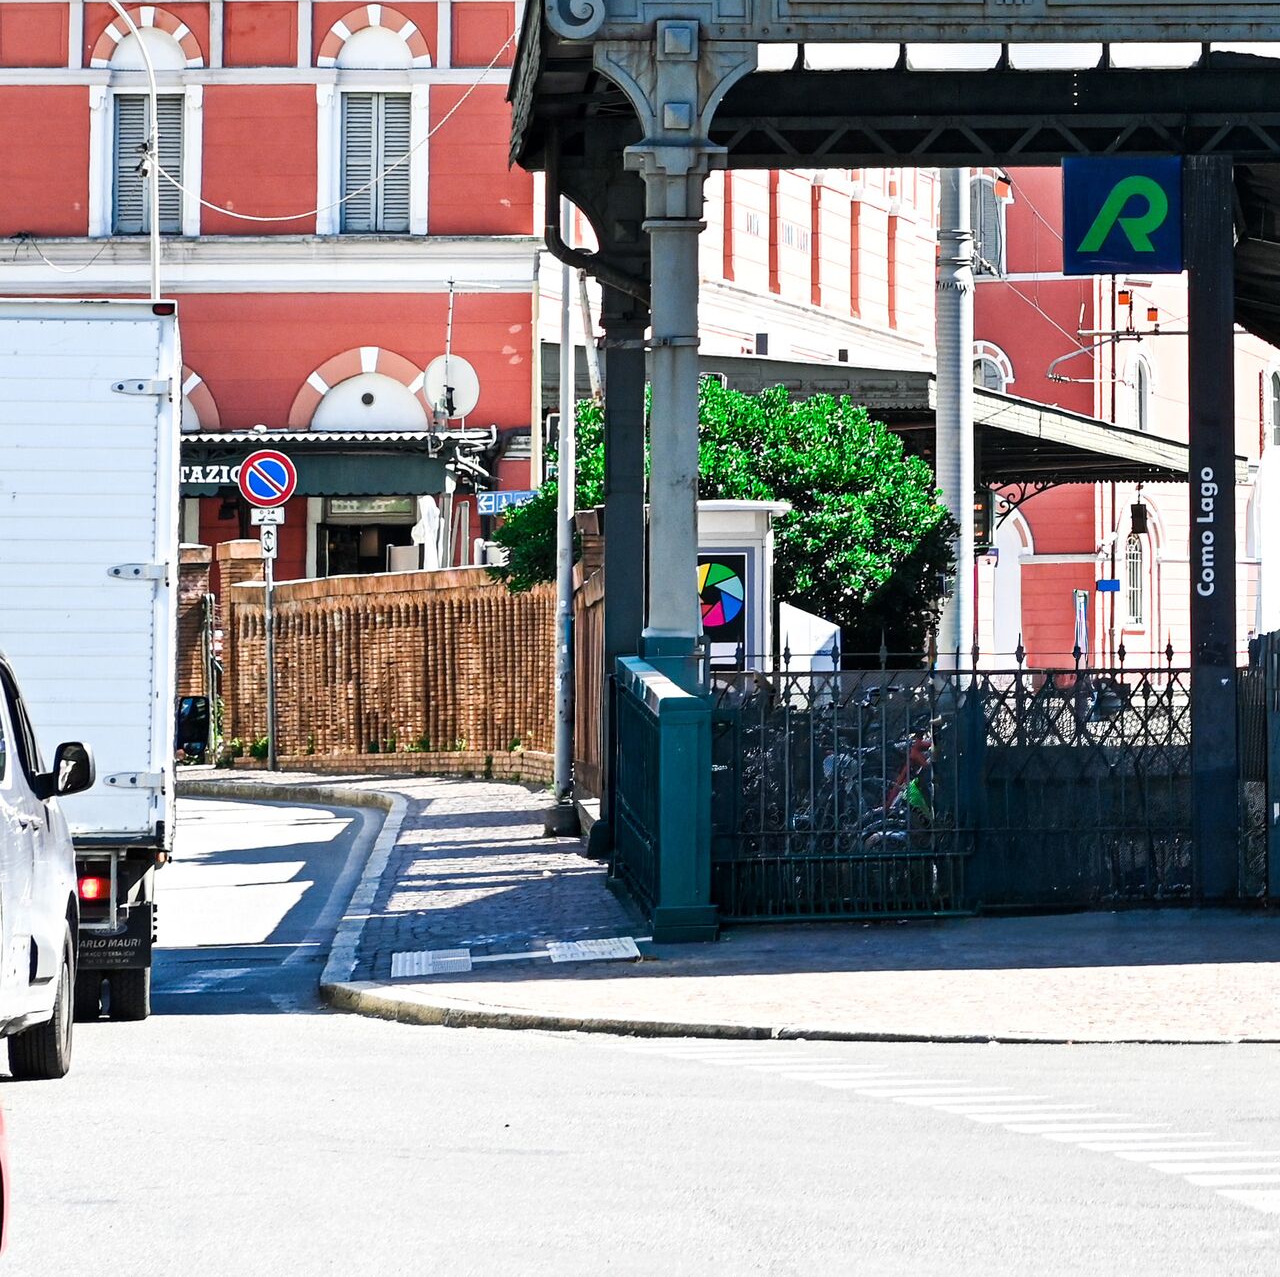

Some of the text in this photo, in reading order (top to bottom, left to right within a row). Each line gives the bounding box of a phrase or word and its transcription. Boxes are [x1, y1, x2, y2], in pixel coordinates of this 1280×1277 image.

[1196, 466, 1218, 596] Como Lago
[108, 939, 141, 947] MAURI
